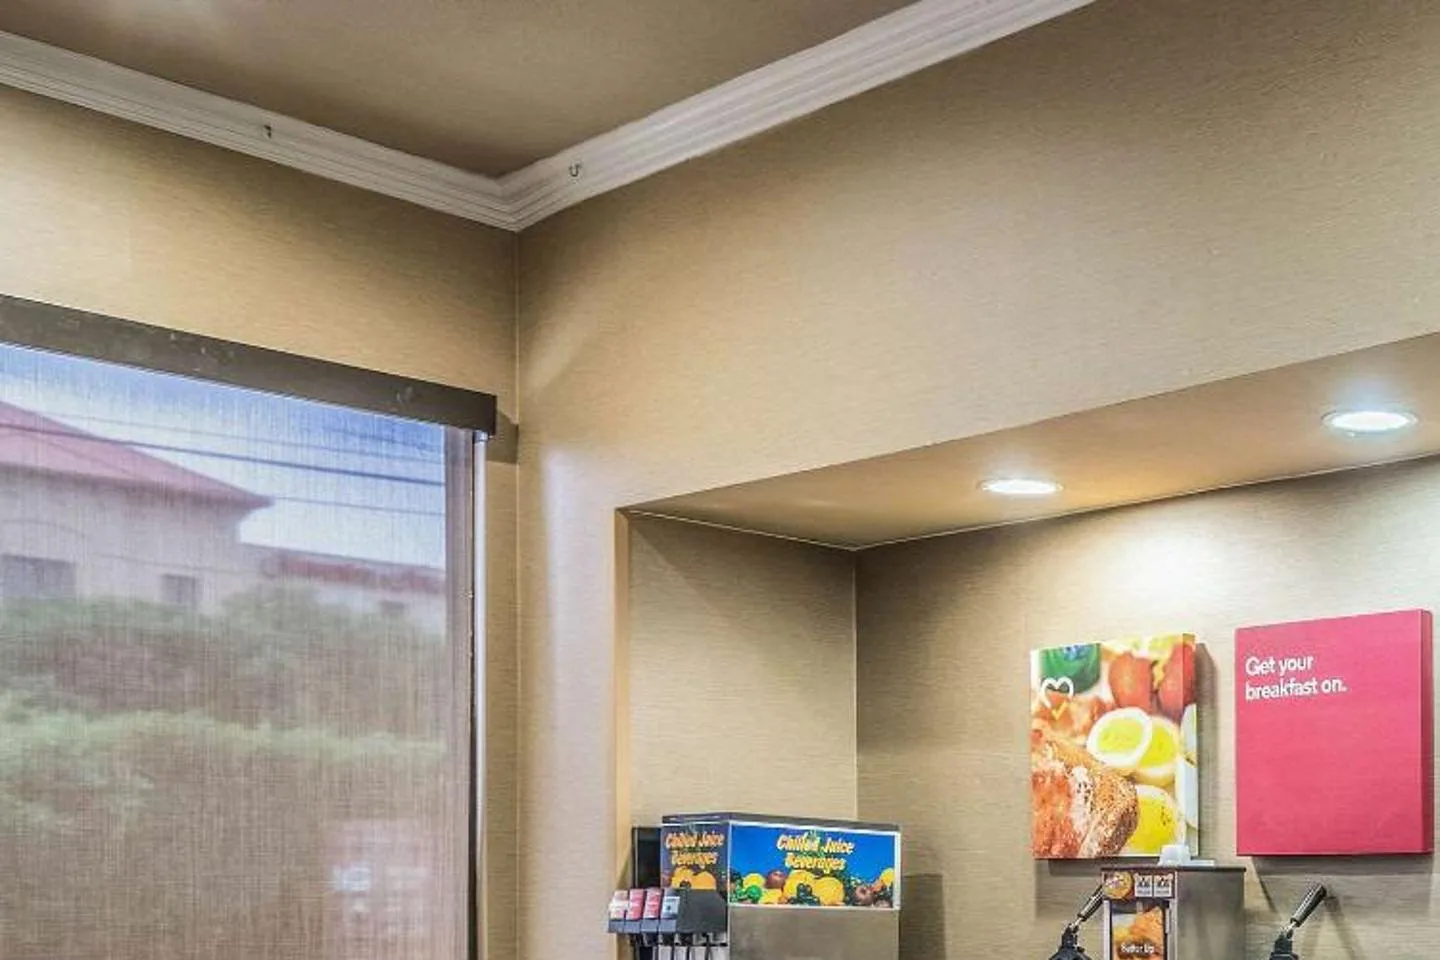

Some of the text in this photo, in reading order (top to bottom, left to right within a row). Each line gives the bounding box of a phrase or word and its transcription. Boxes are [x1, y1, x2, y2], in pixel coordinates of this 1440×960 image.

[1245, 655, 1314, 676] Get your
[1245, 677, 1348, 701] breakfast on.
[776, 831, 855, 854] Chilled Juice
[784, 851, 846, 872] Beverages
